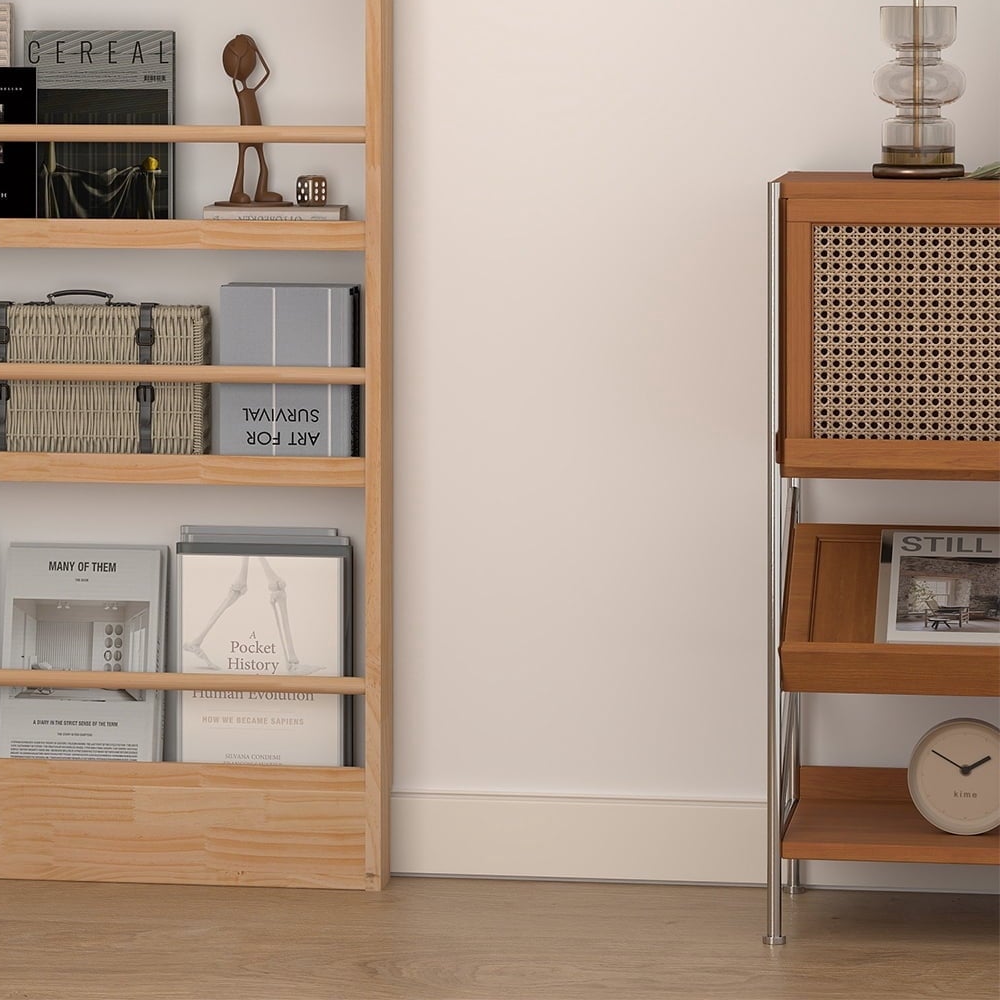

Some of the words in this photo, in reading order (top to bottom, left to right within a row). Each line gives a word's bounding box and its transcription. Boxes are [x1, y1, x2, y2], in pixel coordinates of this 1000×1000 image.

[28, 40, 169, 64] CEREAL
[242, 408, 320, 423] SURVIVAL
[246, 431, 281, 445] FOR
[288, 431, 320, 446] ART
[901, 536, 992, 553] STILL
[48, 561, 75, 571] MANY
[77, 561, 90, 571] OF
[91, 561, 117, 572] THEM
[249, 631, 257, 639] A
[230, 640, 277, 654] Pocket
[227, 657, 280, 674] History
[202, 715, 219, 723] HOW
[221, 716, 234, 724] WE
[236, 716, 268, 725] BECAME
[270, 717, 304, 726] SAPIENS
[953, 790, 978, 798] kime
